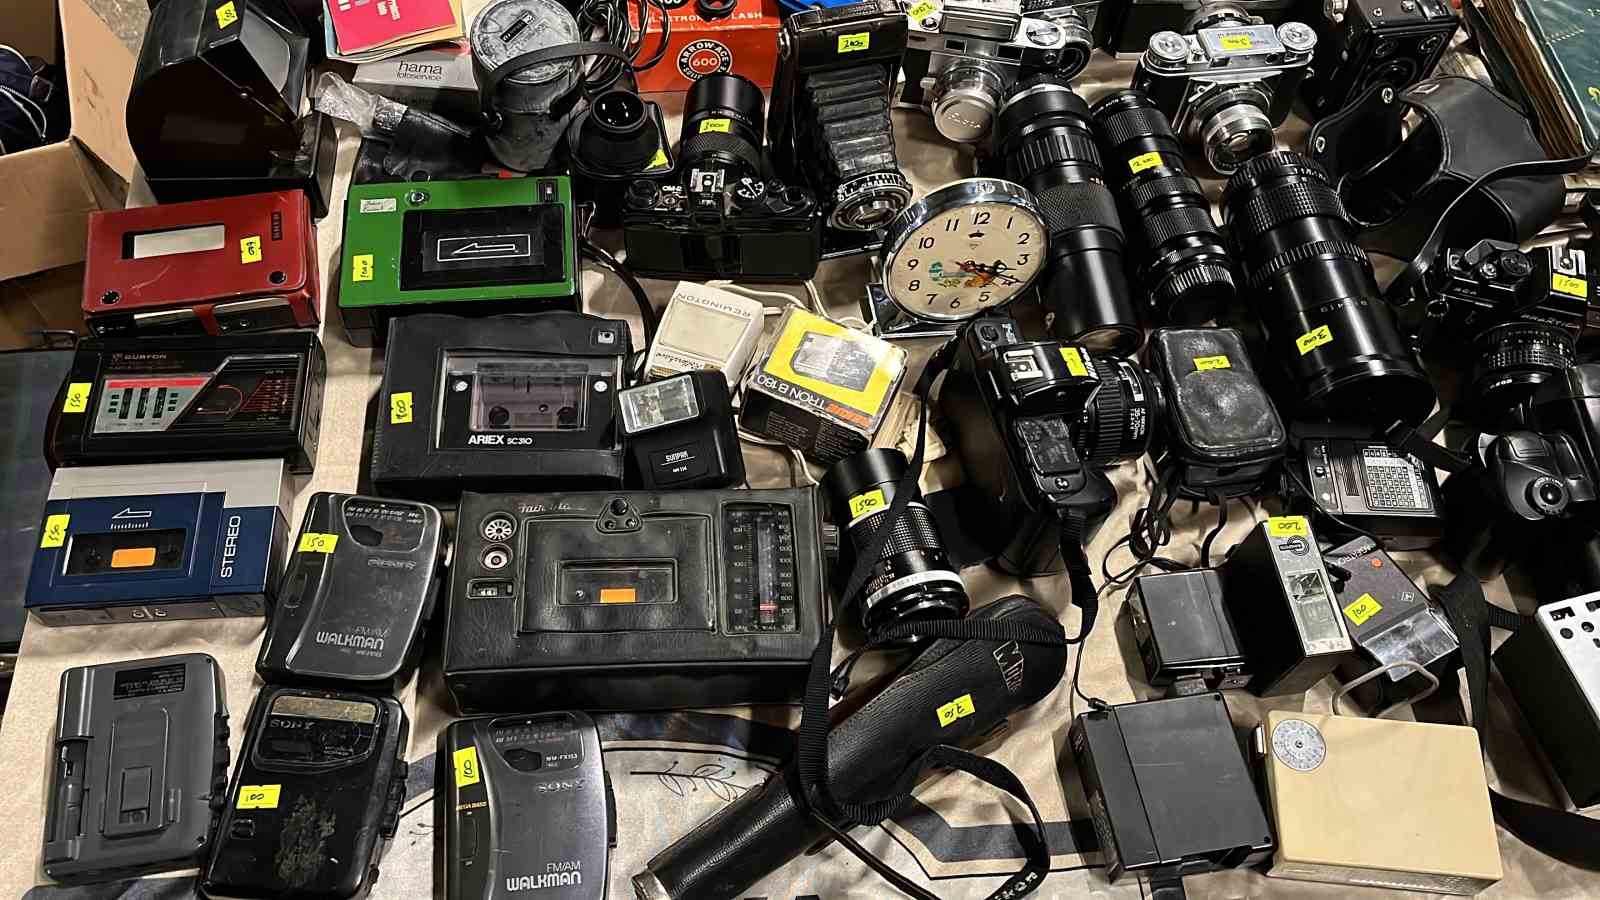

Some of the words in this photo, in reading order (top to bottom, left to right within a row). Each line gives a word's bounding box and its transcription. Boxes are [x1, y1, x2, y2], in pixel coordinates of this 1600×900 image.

[712, 11, 763, 20] LASH
[398, 60, 442, 75] hama
[692, 57, 718, 67] 600
[945, 218, 960, 232] 11
[973, 212, 991, 225] 12
[1006, 216, 1013, 229] 1
[918, 236, 935, 249] 10
[1017, 232, 1030, 245] 2
[907, 258, 919, 271] 9
[1017, 253, 1031, 266] 3
[908, 279, 921, 292] 8
[926, 293, 939, 305] 7
[950, 297, 961, 309] 6
[978, 291, 992, 302] 5
[675, 292, 752, 317] REMINGTON
[789, 388, 826, 410] TRON
[1131, 407, 1141, 440] 35-70mm
[468, 434, 505, 445] ARIEX
[506, 437, 534, 445] SC310
[220, 515, 241, 578] STEREO
[316, 631, 385, 650] WALKMAN
[463, 759, 474, 779] 100
[538, 778, 585, 792] SONY
[546, 860, 582, 873] FM/AM
[506, 871, 582, 892] WALKMAN
